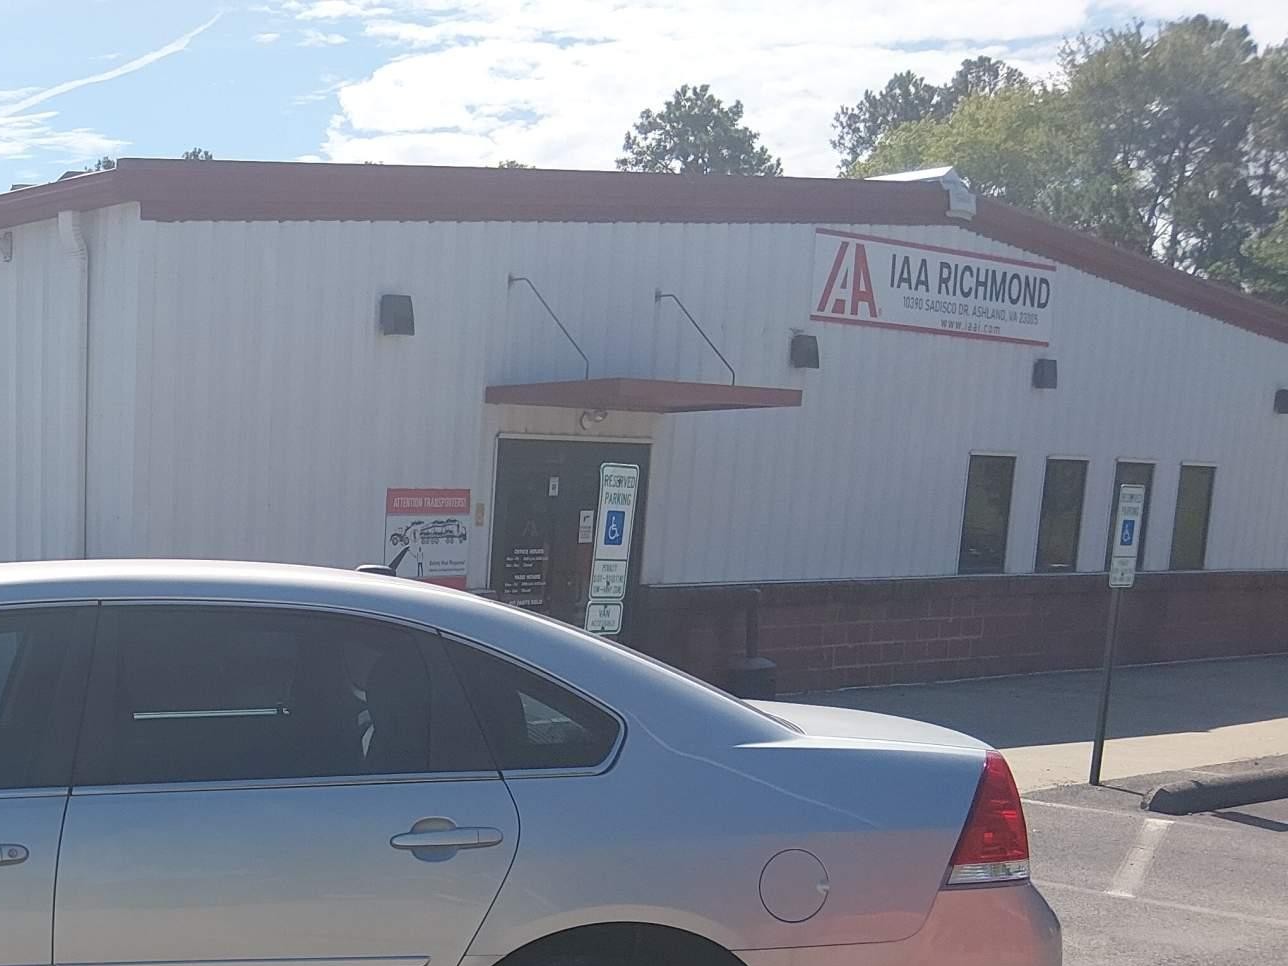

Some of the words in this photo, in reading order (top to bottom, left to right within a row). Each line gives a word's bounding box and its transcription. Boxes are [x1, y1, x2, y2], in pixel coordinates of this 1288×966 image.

[890, 253, 930, 293] IAA
[937, 261, 1051, 309] RICHMOND
[903, 296, 923, 311] 10390
[925, 299, 957, 315] SADISCO
[604, 474, 636, 488] RESERVED
[604, 492, 632, 506] PARKING
[599, 608, 610, 618] VAN
